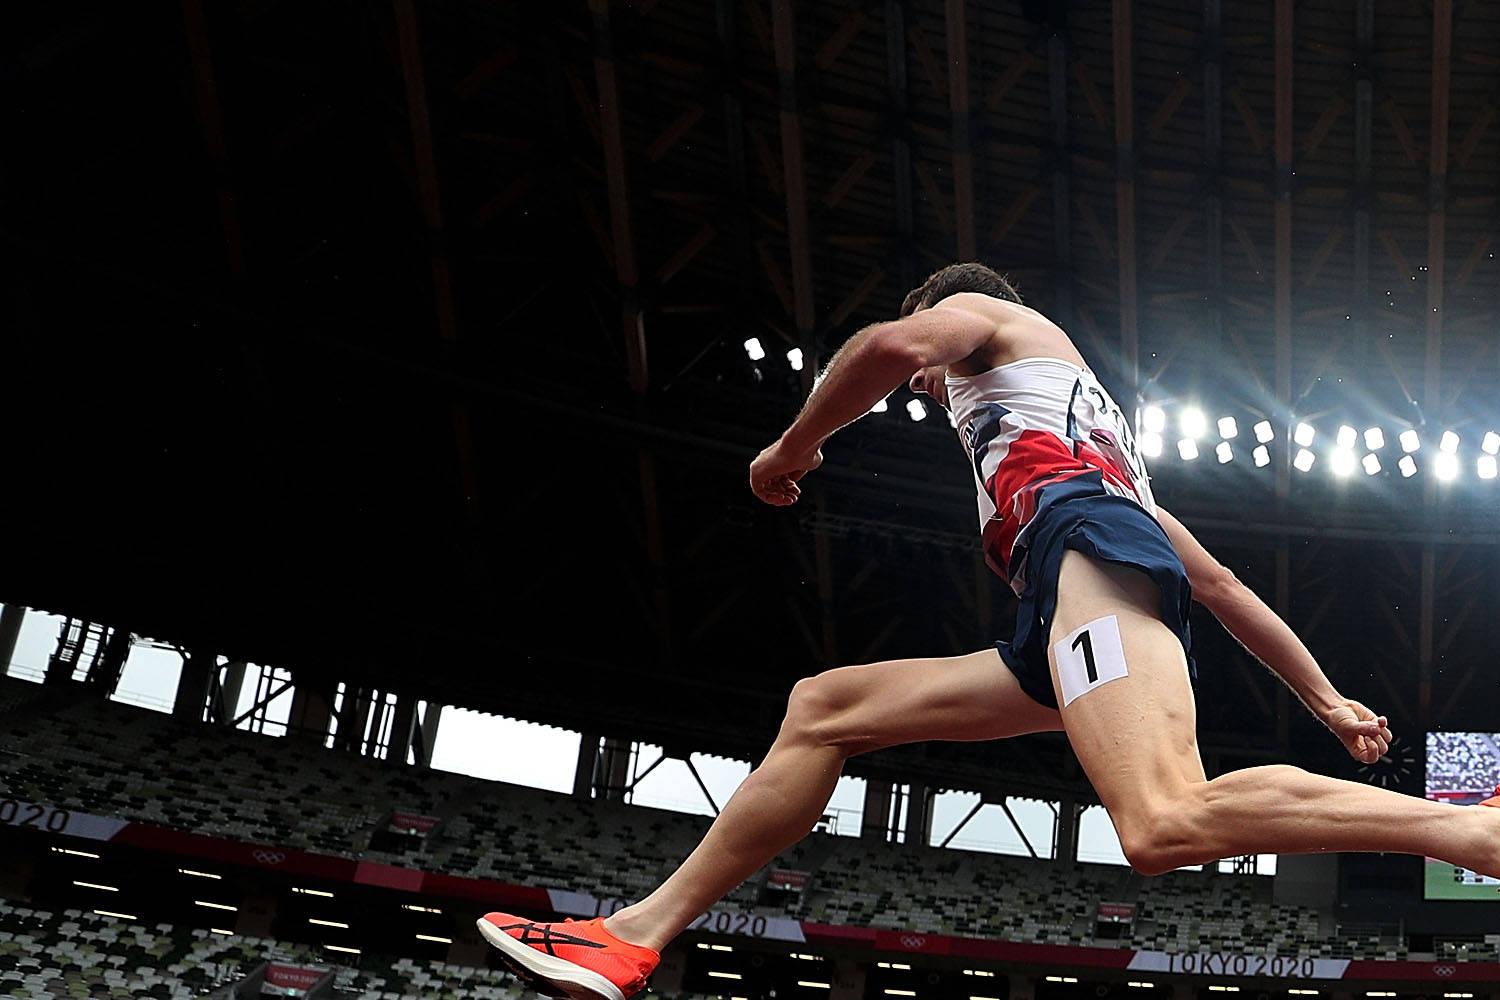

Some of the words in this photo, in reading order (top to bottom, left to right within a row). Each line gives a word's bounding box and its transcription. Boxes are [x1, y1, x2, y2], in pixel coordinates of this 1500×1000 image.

[1071, 629, 1099, 684] 1
[701, 911, 768, 937] 2020
[1166, 951, 1247, 976] TOKYO
[1254, 956, 1315, 978] 2020
